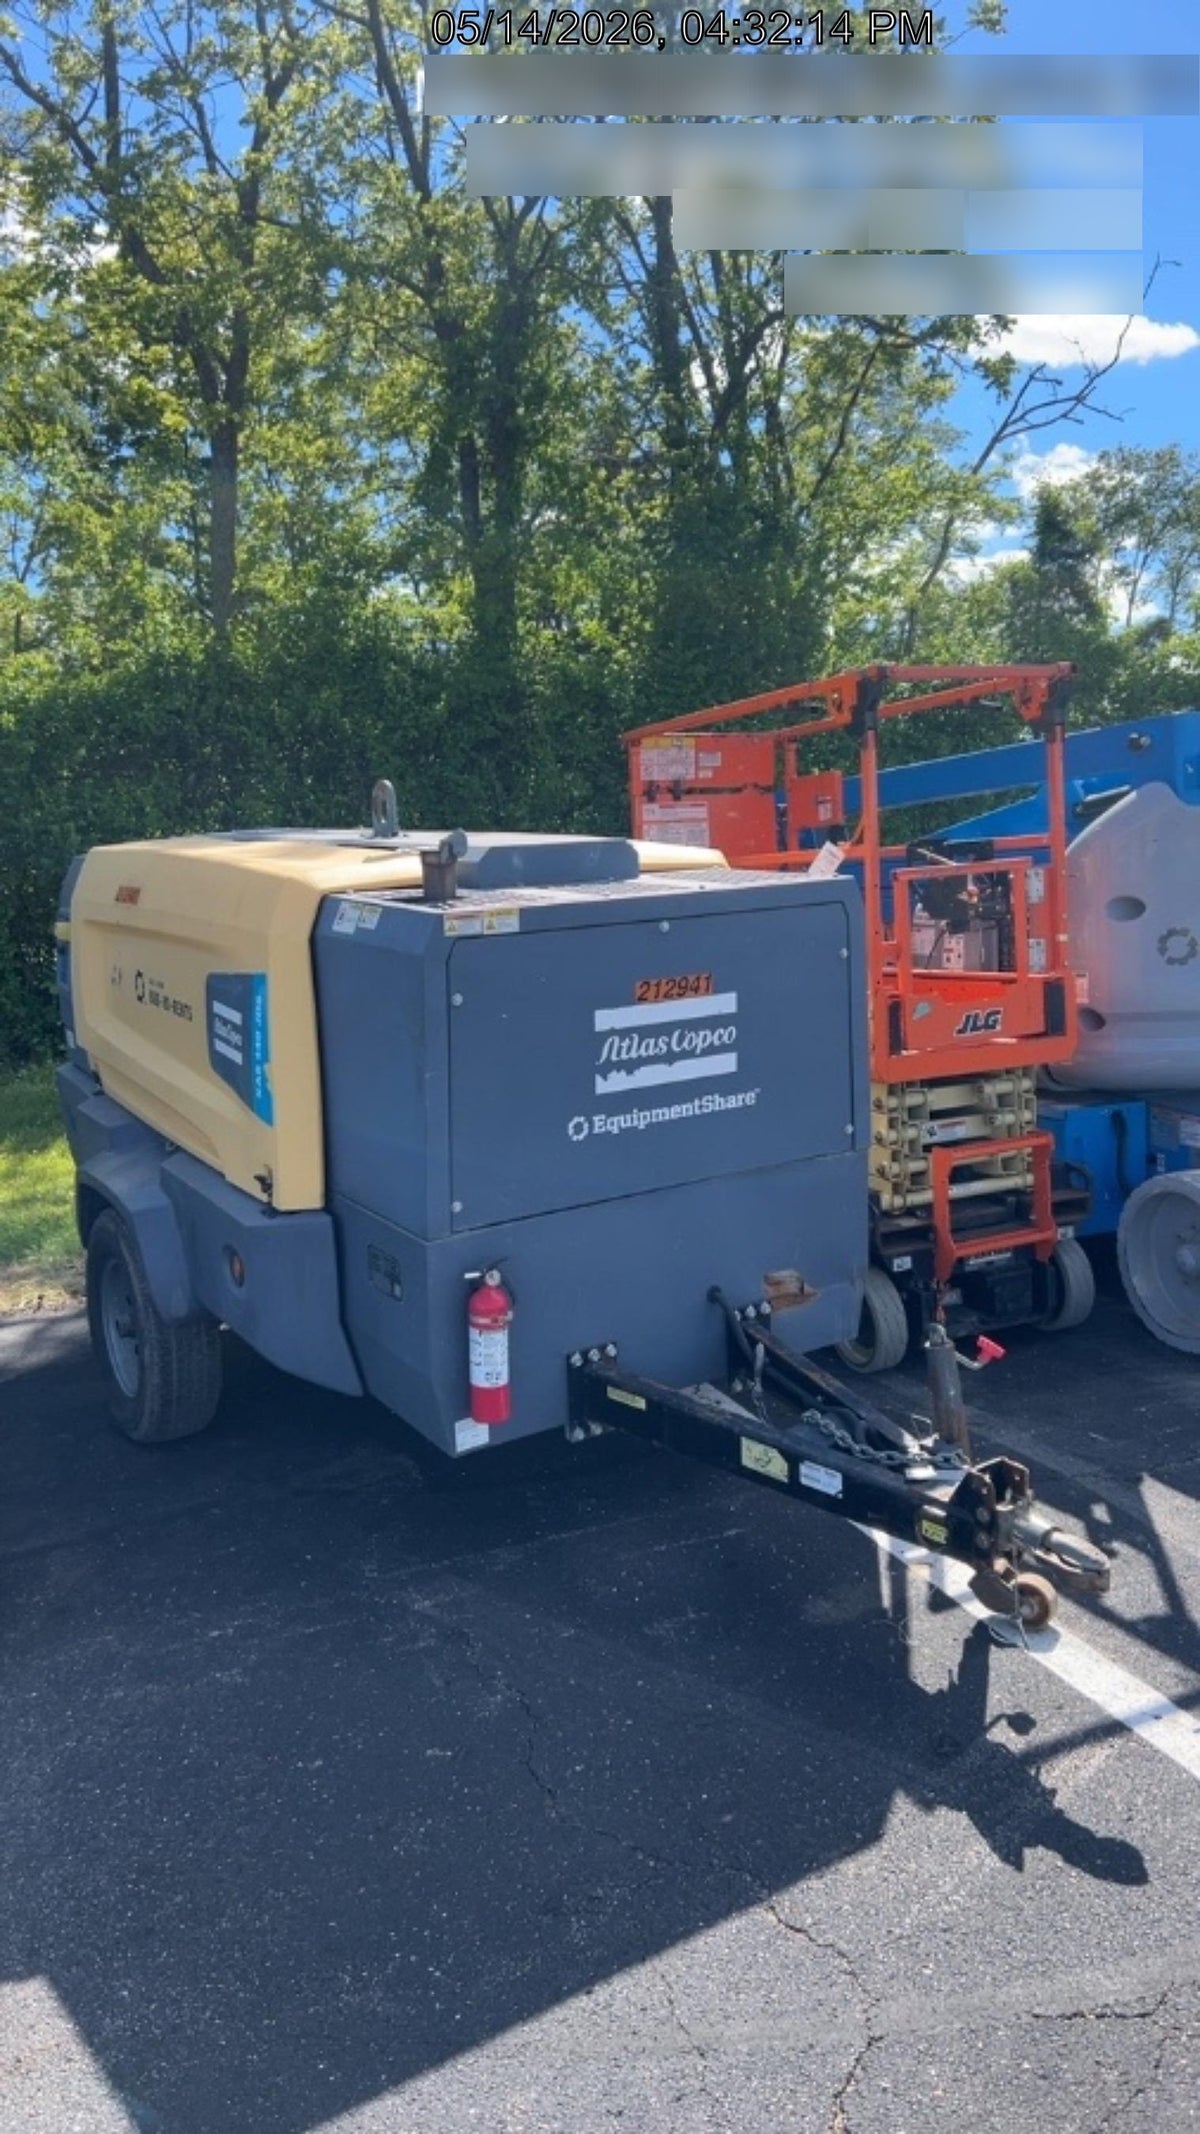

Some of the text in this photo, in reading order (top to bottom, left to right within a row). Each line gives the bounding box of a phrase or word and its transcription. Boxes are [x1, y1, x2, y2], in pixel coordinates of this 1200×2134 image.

[637, 972, 712, 1001] 212941
[954, 1008, 1003, 1036] JLG
[592, 1090, 757, 1134] EquipmentShare
